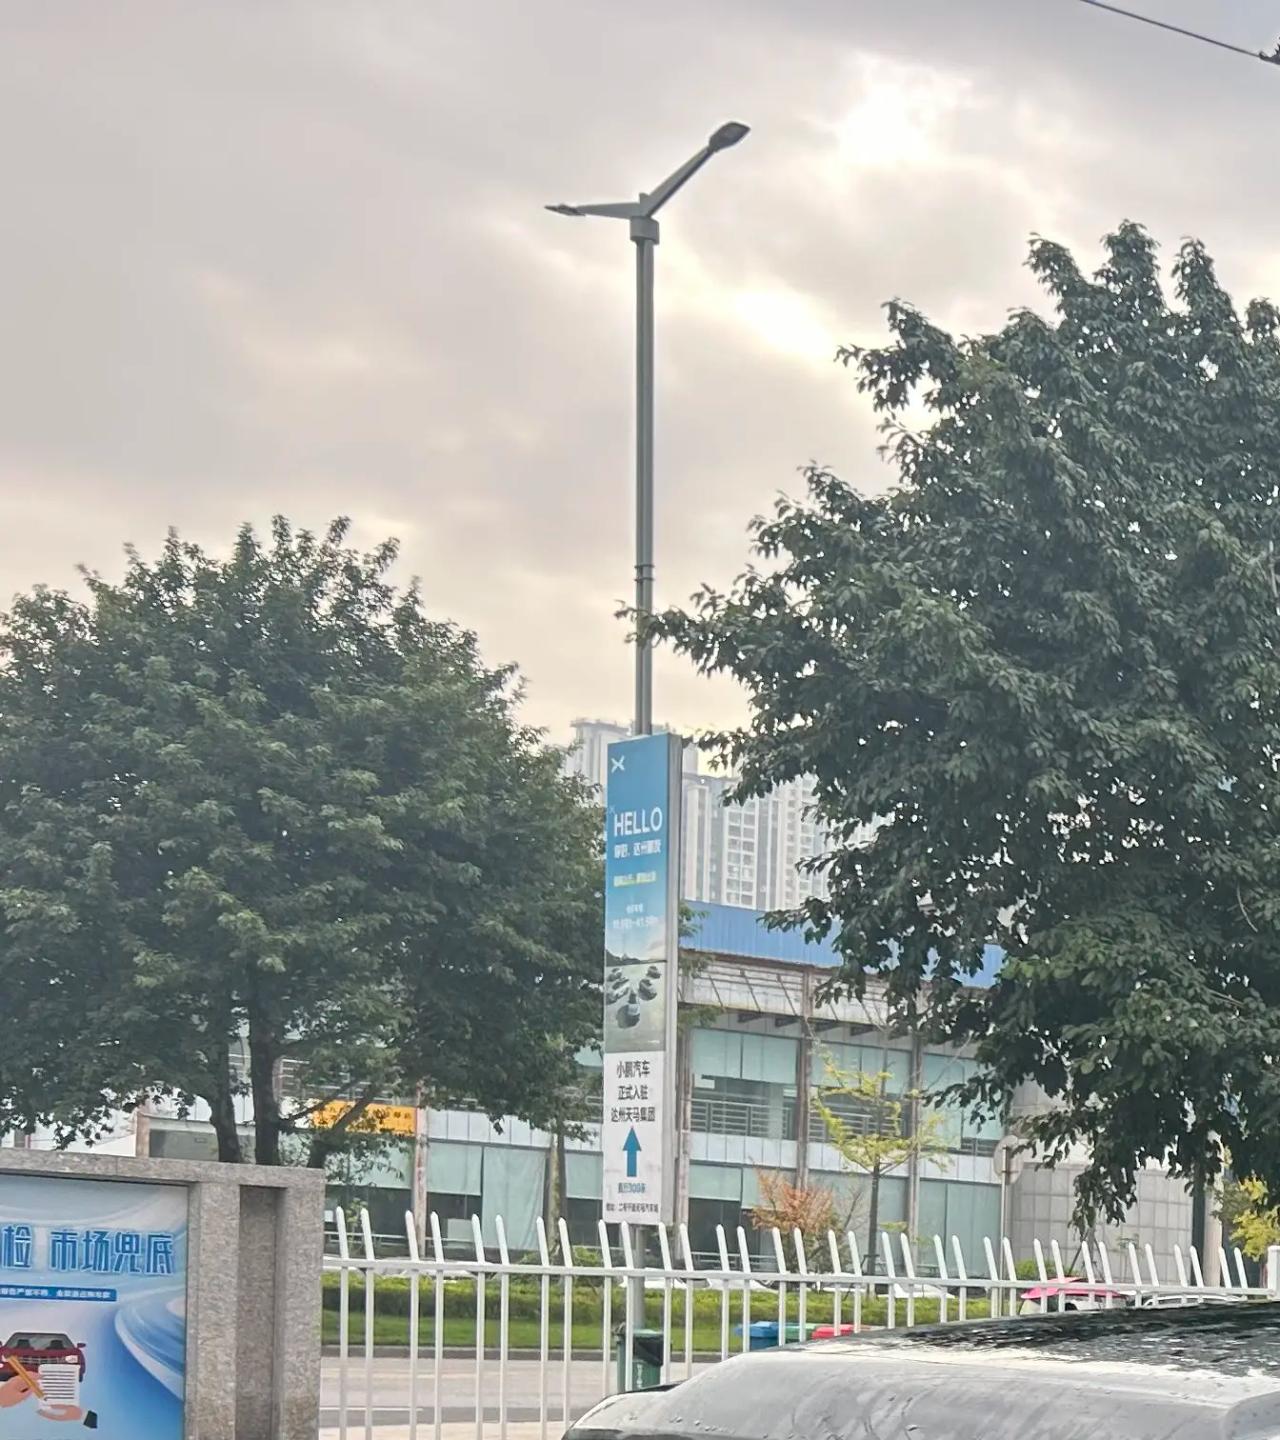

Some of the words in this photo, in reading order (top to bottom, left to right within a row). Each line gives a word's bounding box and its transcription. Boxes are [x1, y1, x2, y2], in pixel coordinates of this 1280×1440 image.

[613, 806, 663, 837] HELLO
[618, 1084, 648, 1100] 正式入驻
[2, 1225, 32, 1269] 检
[49, 1229, 174, 1275] 市场兜底
